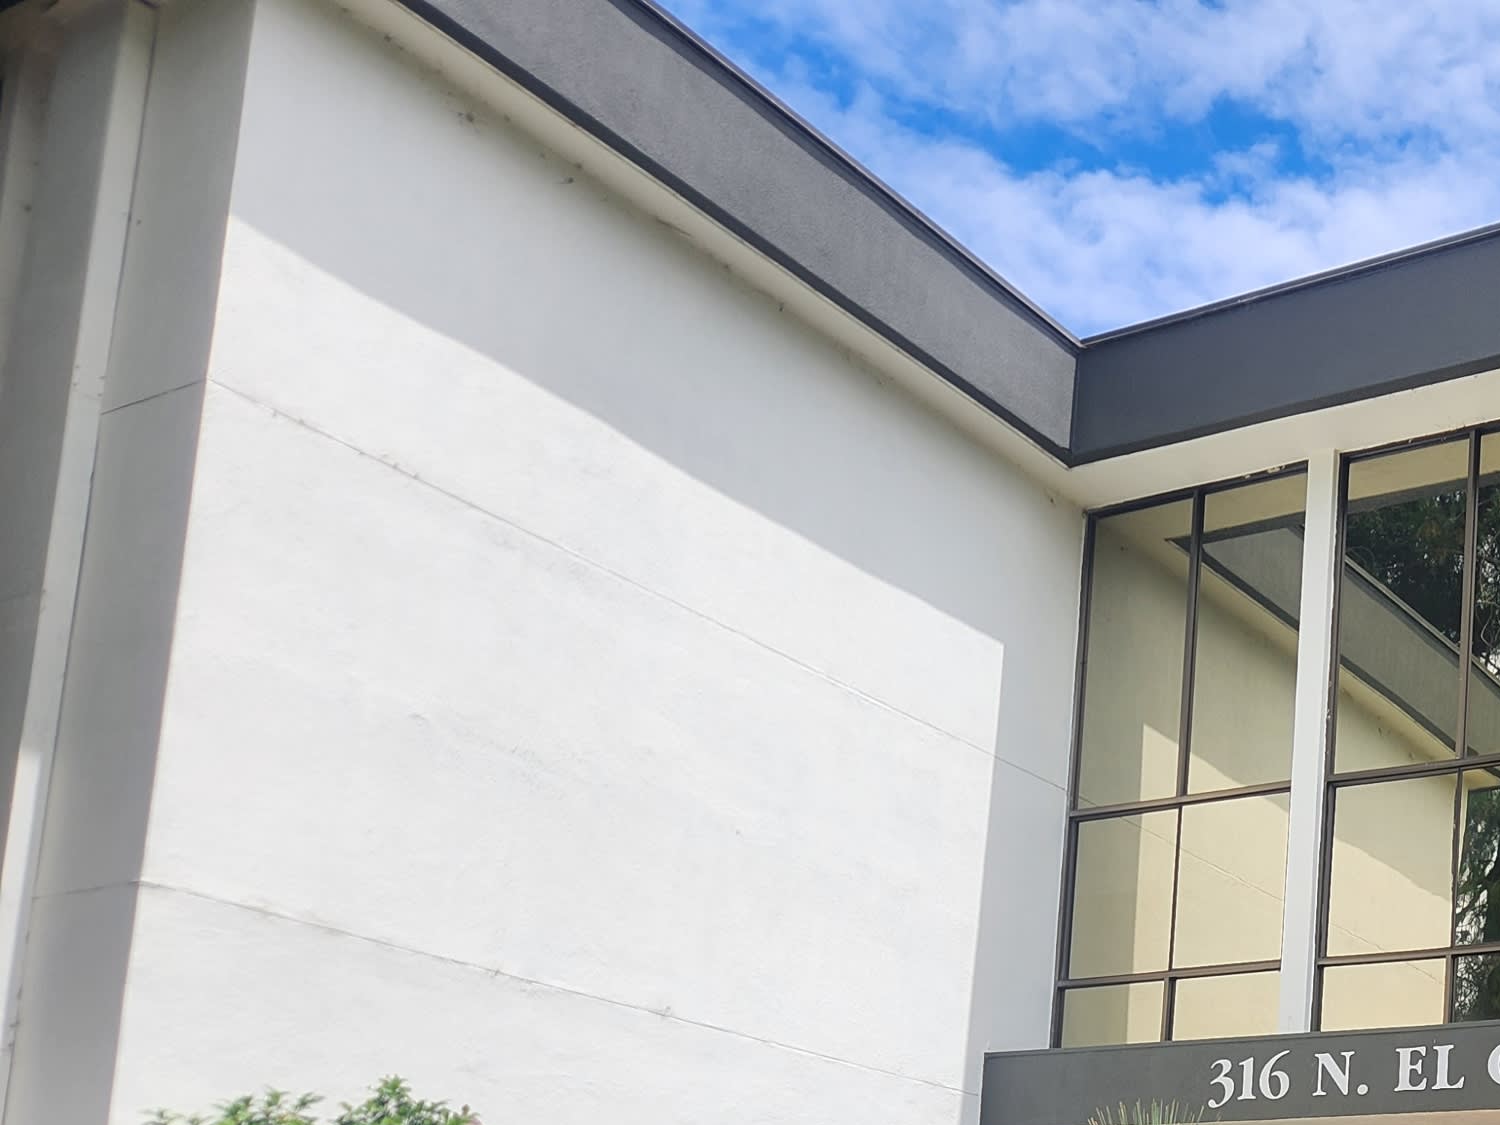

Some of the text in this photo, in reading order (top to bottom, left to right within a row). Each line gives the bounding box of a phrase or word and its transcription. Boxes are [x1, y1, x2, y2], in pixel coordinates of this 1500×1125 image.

[1207, 1049, 1291, 1109] 316
[1311, 1050, 1370, 1097] N.
[1393, 1044, 1466, 1093] EL
